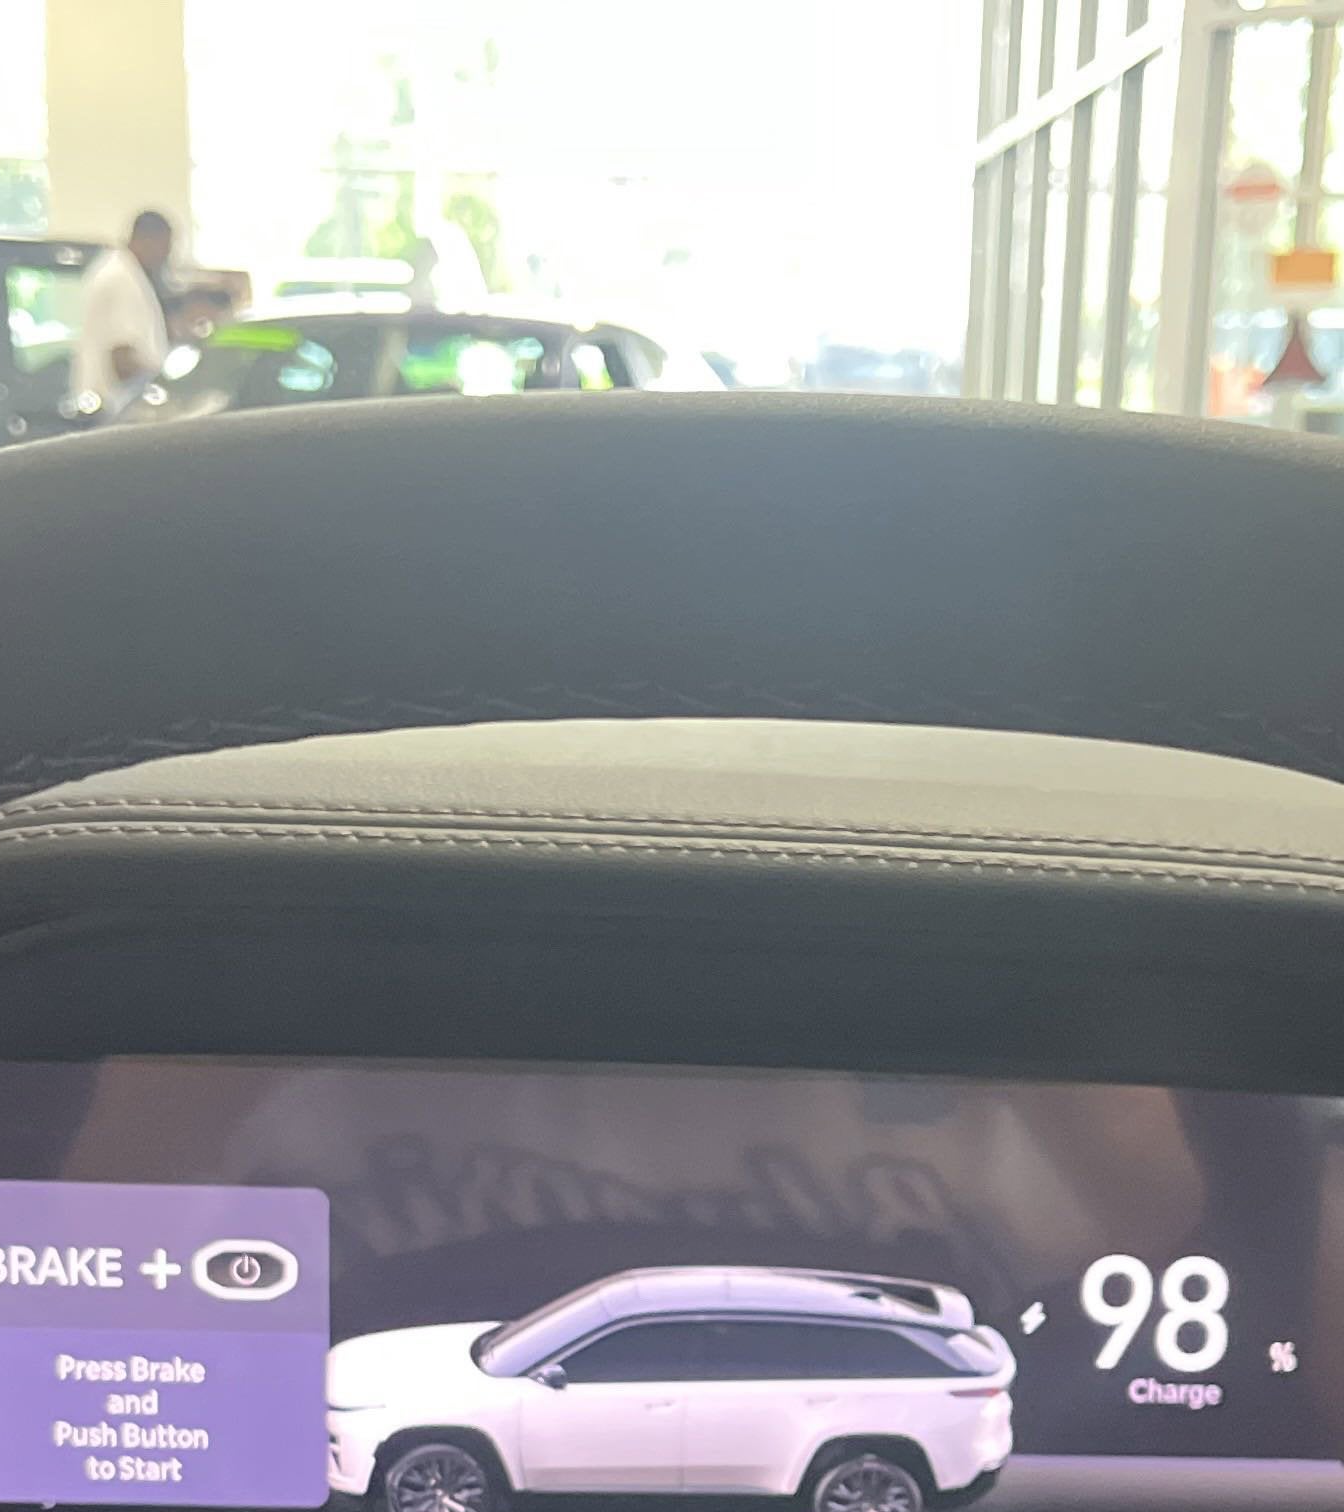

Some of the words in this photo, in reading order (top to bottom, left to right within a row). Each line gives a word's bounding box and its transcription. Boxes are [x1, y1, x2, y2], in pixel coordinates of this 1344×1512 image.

[1080, 1254, 1229, 1372] 98
[1268, 1341, 1296, 1372] %
[56, 1353, 127, 1383] Press
[130, 1356, 206, 1384] Brake
[106, 1390, 159, 1416] and
[1128, 1376, 1222, 1411] Charge
[53, 1420, 118, 1449] Push
[121, 1421, 209, 1450] Button
[86, 1457, 116, 1480] to
[120, 1456, 184, 1482] Start
